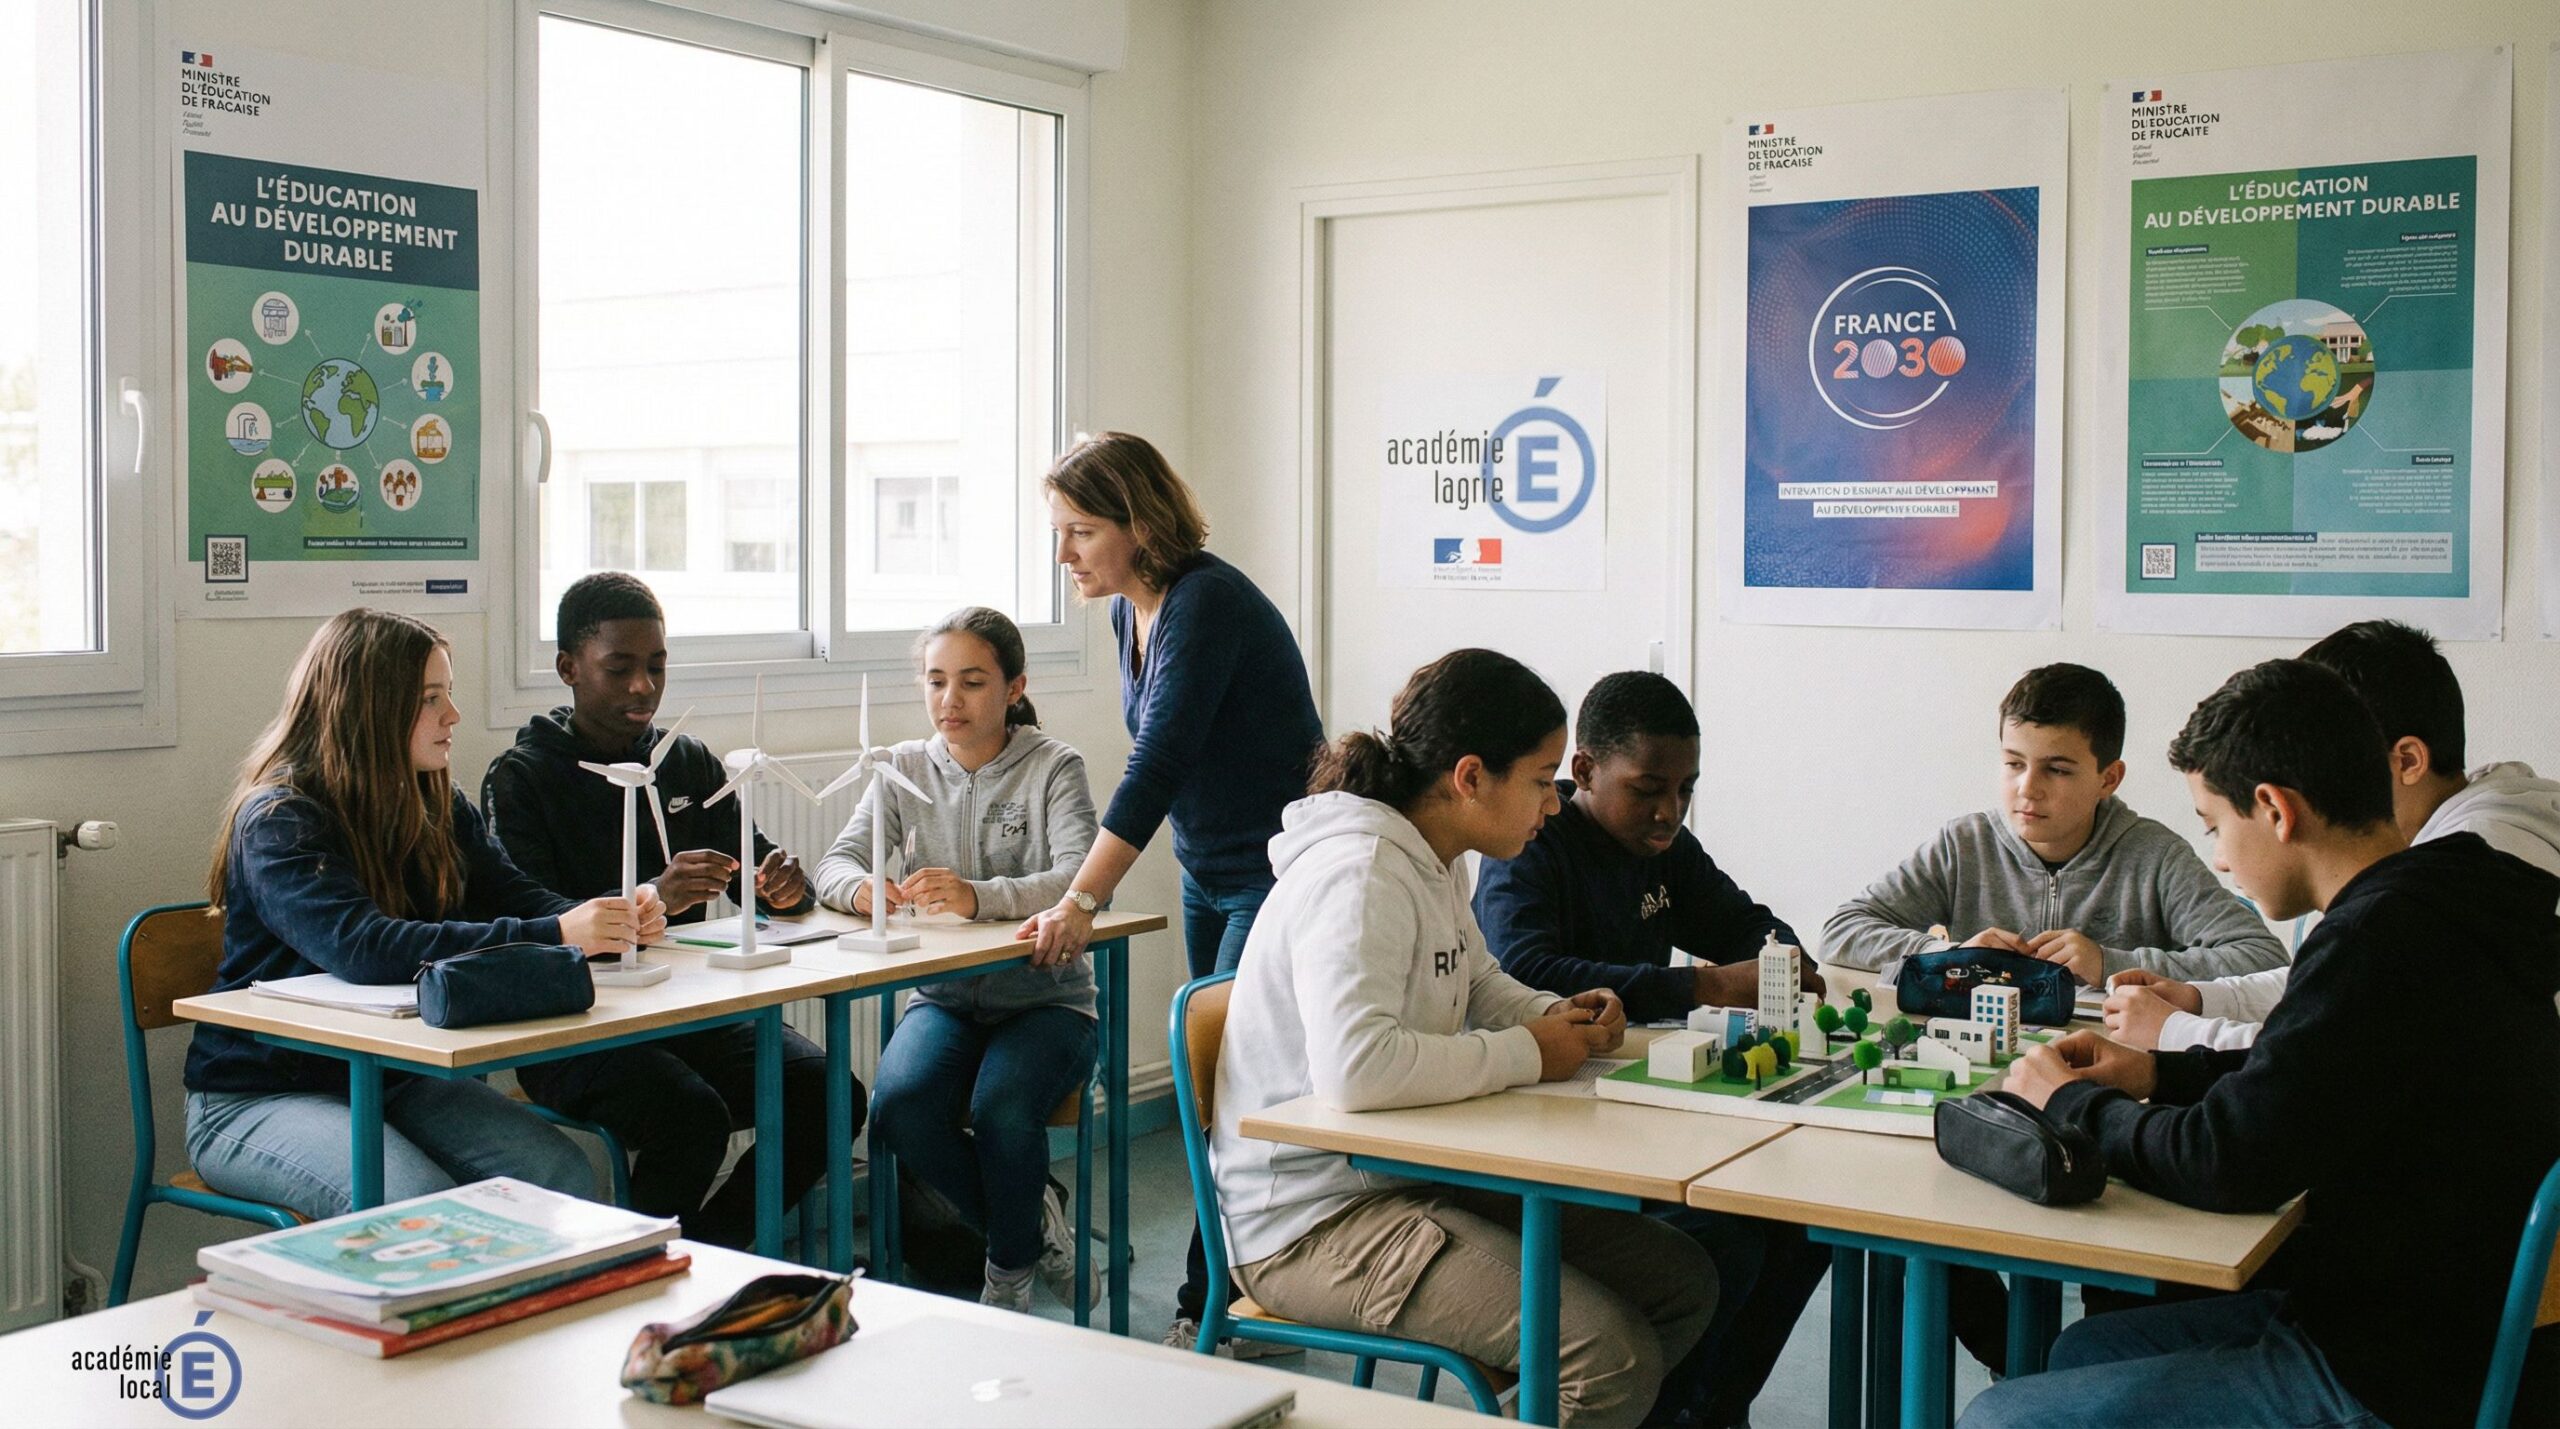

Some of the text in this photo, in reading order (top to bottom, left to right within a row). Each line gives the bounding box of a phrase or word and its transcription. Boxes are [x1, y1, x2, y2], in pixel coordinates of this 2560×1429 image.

[182, 68, 240, 87] MINISTRE
[182, 95, 260, 116] DE FRACAISE
[2131, 104, 2187, 117] MINISTRE
[1748, 136, 1797, 148] MINISTRE
[2131, 126, 2209, 141] DE FRUCAITE
[1748, 157, 1813, 171] DE FRACAISE
[257, 174, 417, 217] L'ÉDUCATION
[2229, 176, 2369, 202] L'ÉDUCATION
[2144, 192, 2461, 229] AU DÉVELOPPEMENT DURABLE
[211, 201, 458, 250] AU DÉVELOPPEMENT
[284, 239, 393, 272] DURABLE
[1834, 311, 1937, 335] FRANCE
[1833, 335, 1967, 379] 2030
[1387, 429, 1504, 465] académie
[1434, 468, 1504, 511] lagrie
